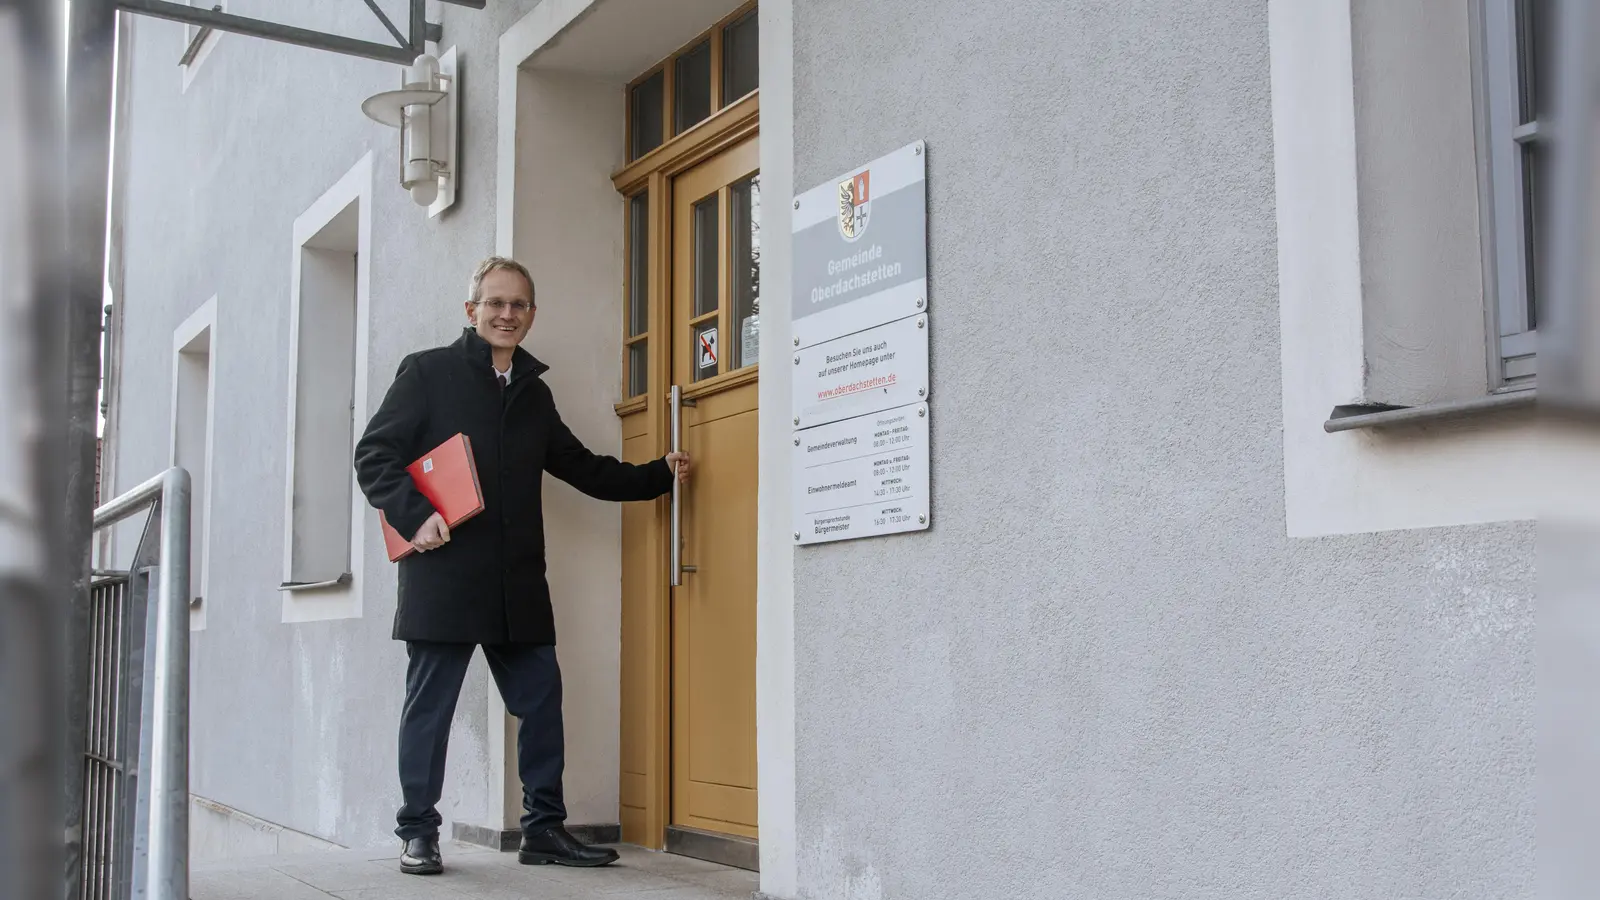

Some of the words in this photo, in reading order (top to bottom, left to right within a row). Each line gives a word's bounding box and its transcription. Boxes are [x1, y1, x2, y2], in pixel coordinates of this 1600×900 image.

[828, 243, 882, 276] Gemeinde
[811, 262, 902, 303] Oberdachstetten
[826, 351, 852, 364] Besuchen
[852, 348, 862, 357] Sie
[862, 345, 872, 354] uns
[874, 340, 888, 351] auch
[818, 368, 828, 378] auf
[828, 364, 848, 376] unserer
[850, 356, 878, 370] Homepage
[880, 352, 896, 362] unter
[818, 373, 896, 399] www.oberdachstetten.de
[808, 436, 858, 452] Gemeindeverwaltung
[808, 480, 857, 494] Einwohnermeldeamt
[815, 523, 850, 534] Bürgermeister
